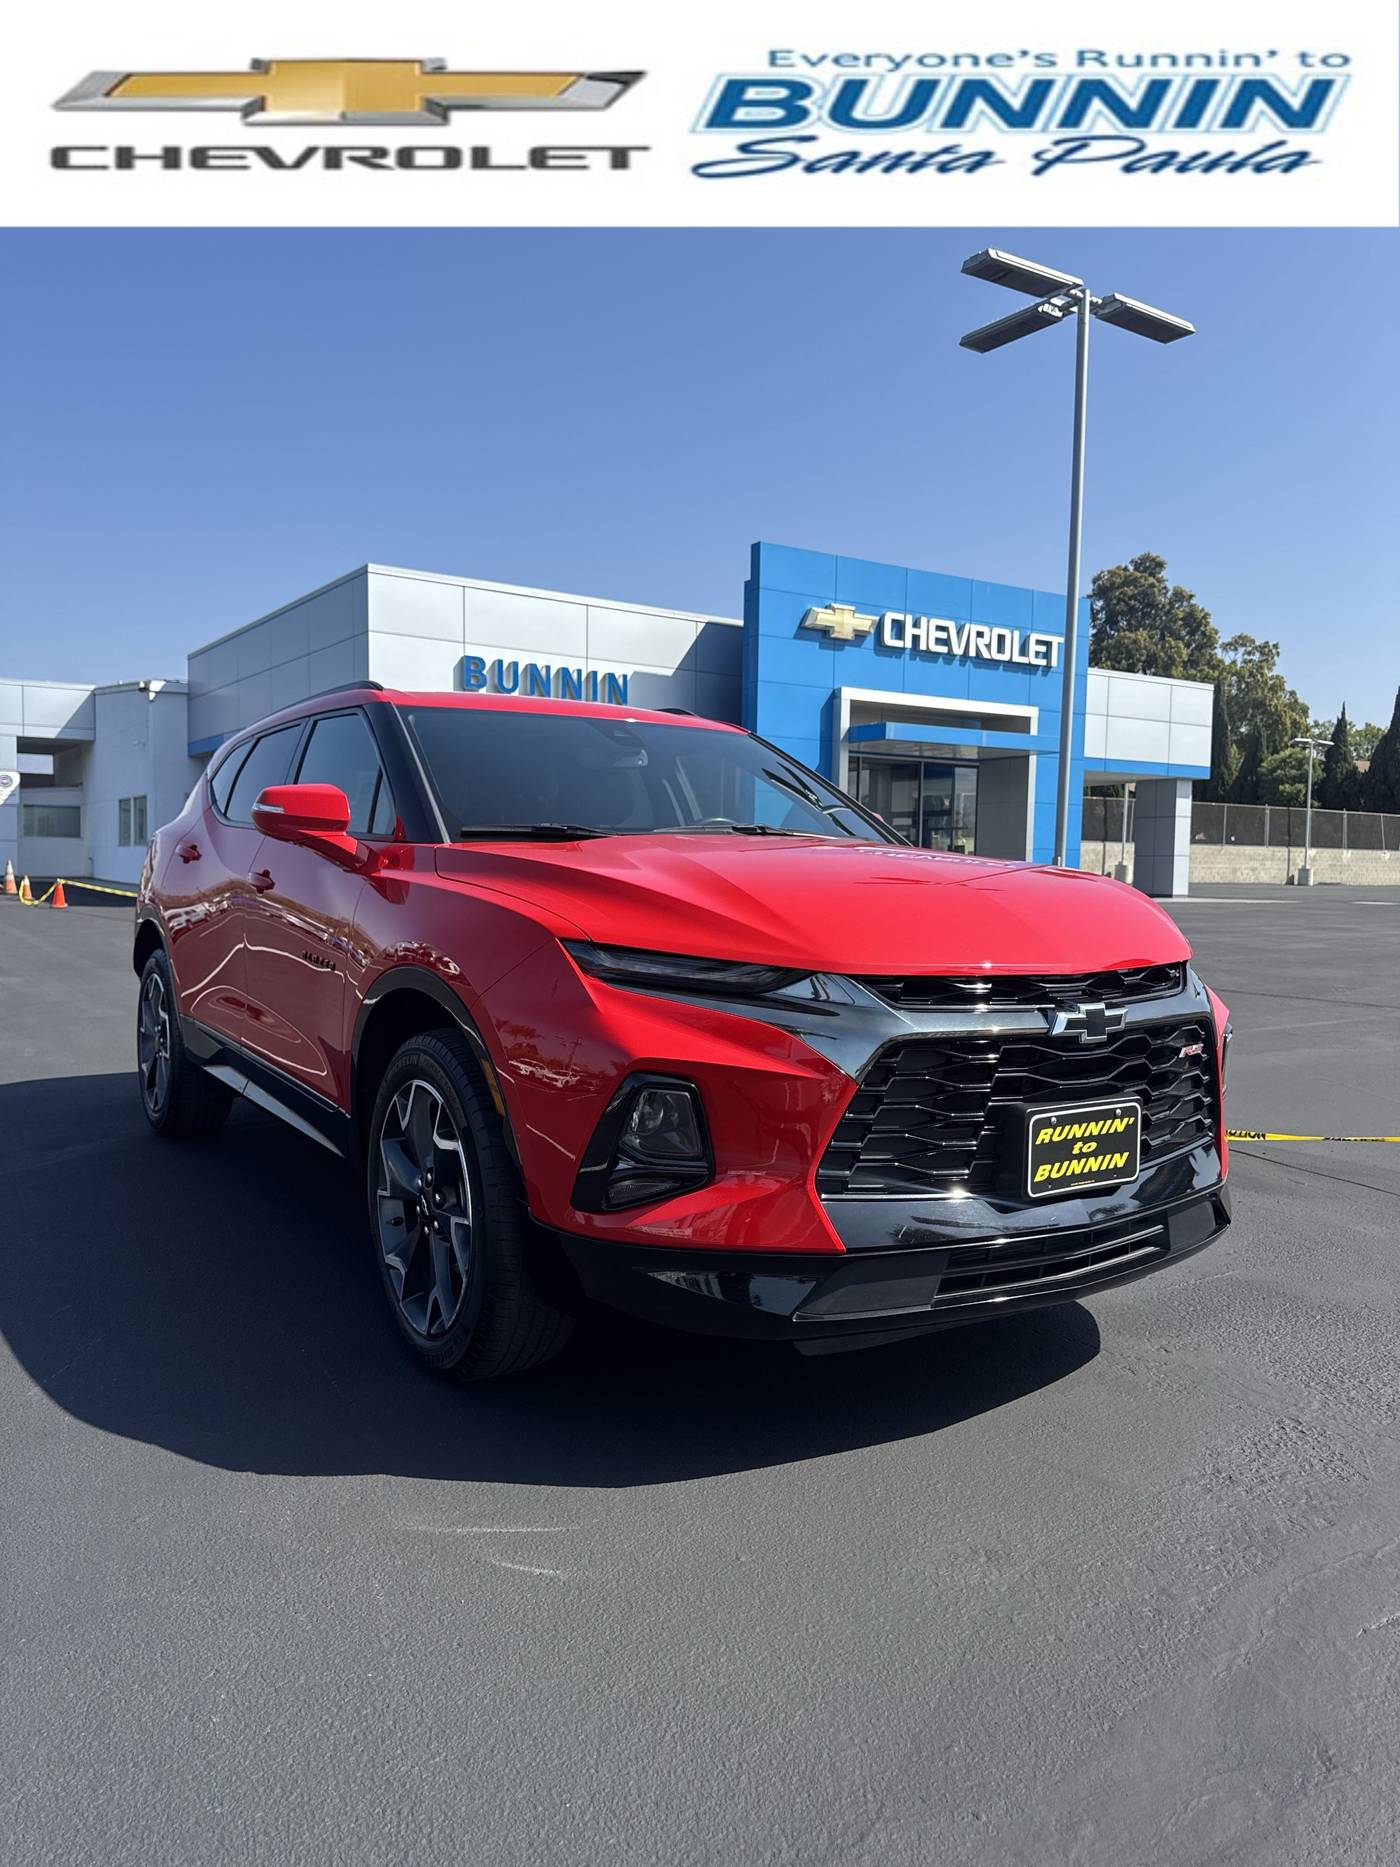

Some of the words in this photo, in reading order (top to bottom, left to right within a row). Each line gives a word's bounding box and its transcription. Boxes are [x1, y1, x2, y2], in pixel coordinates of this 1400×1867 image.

[883, 611, 1064, 667] CHEVROLET
[454, 655, 628, 706] BUNNIN
[1035, 1117, 1135, 1145] RUNNIN'
[1072, 1141, 1097, 1155] to
[1033, 1152, 1130, 1183] BUNNIN
